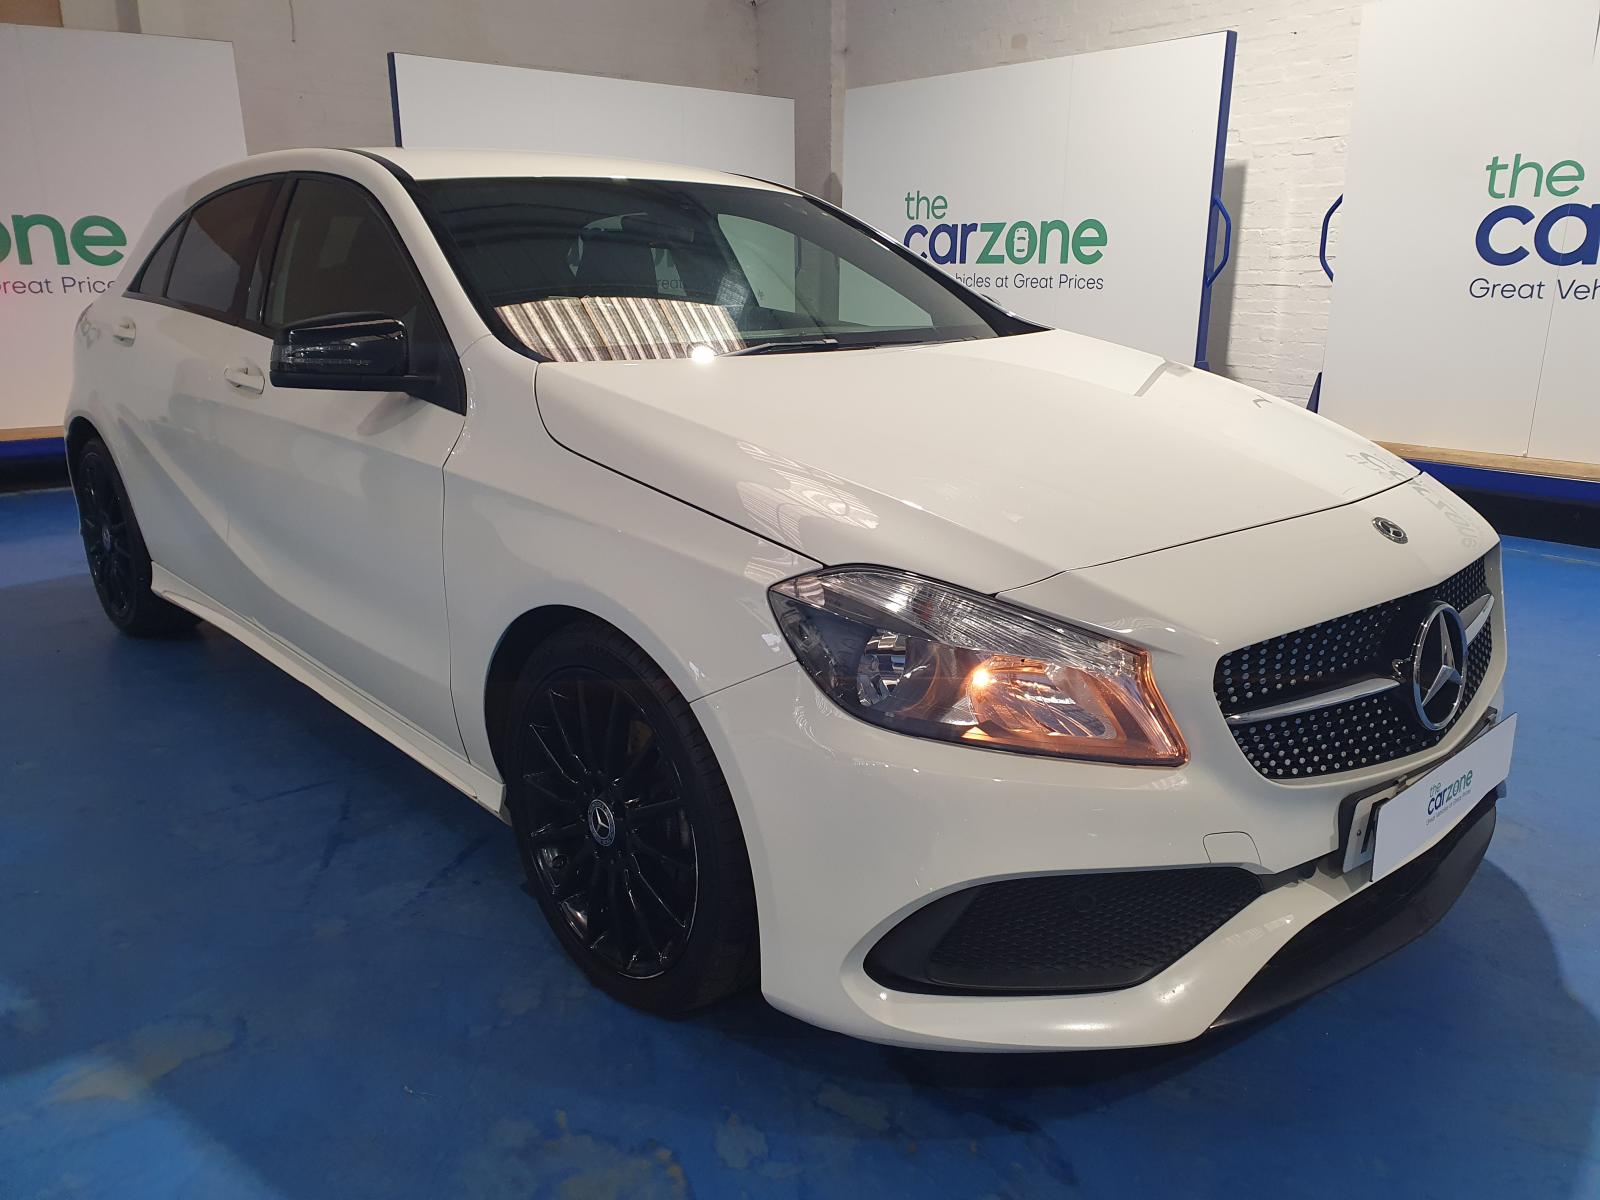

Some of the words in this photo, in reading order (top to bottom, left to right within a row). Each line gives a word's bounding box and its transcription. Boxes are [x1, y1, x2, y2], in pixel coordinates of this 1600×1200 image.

[1486, 153, 1585, 199] the
[904, 190, 948, 220] the
[903, 218, 1108, 265] carzone
[0, 278, 54, 294] reat
[995, 275, 1009, 288] at
[1013, 273, 1054, 289] Great
[1058, 273, 1104, 290] Prices
[1469, 277, 1546, 299] Great
[1427, 769, 1473, 816] carzone
